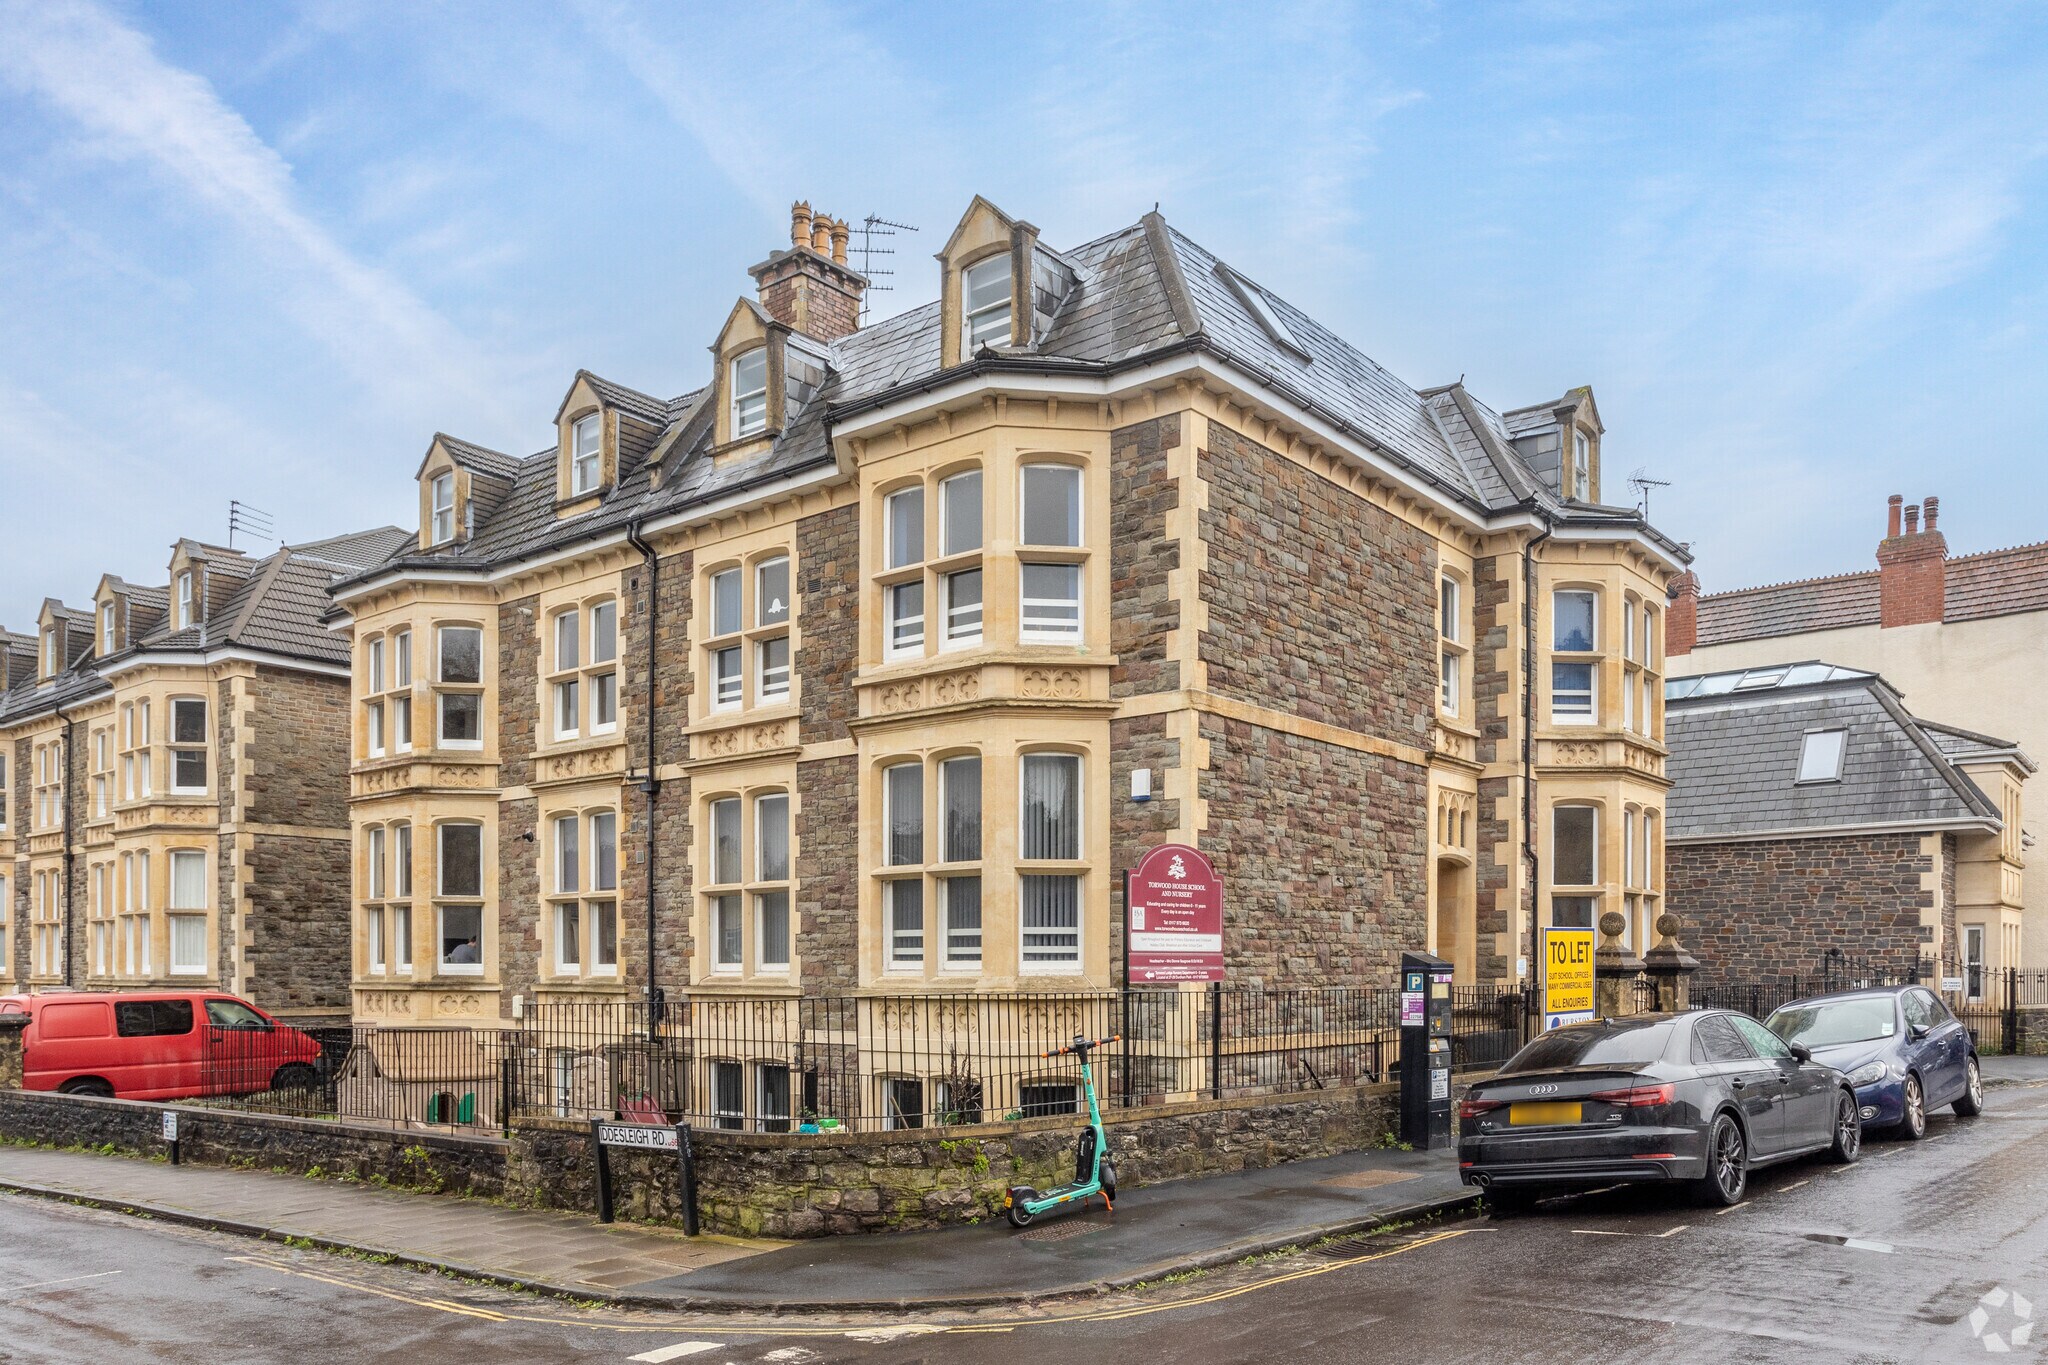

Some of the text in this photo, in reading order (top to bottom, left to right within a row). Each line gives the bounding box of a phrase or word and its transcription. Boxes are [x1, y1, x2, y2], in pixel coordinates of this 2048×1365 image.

[1148, 882, 1171, 890] TORWOOD
[1550, 941, 1590, 964] TO LET
[1575, 971, 1589, 979] OFFICES
[1412, 976, 1421, 989] P
[1559, 982, 1582, 990] COMMERCIAL
[1552, 997, 1588, 1009] ALL ENQUIRIES
[599, 1126, 648, 1145] IDDESLEIGH
